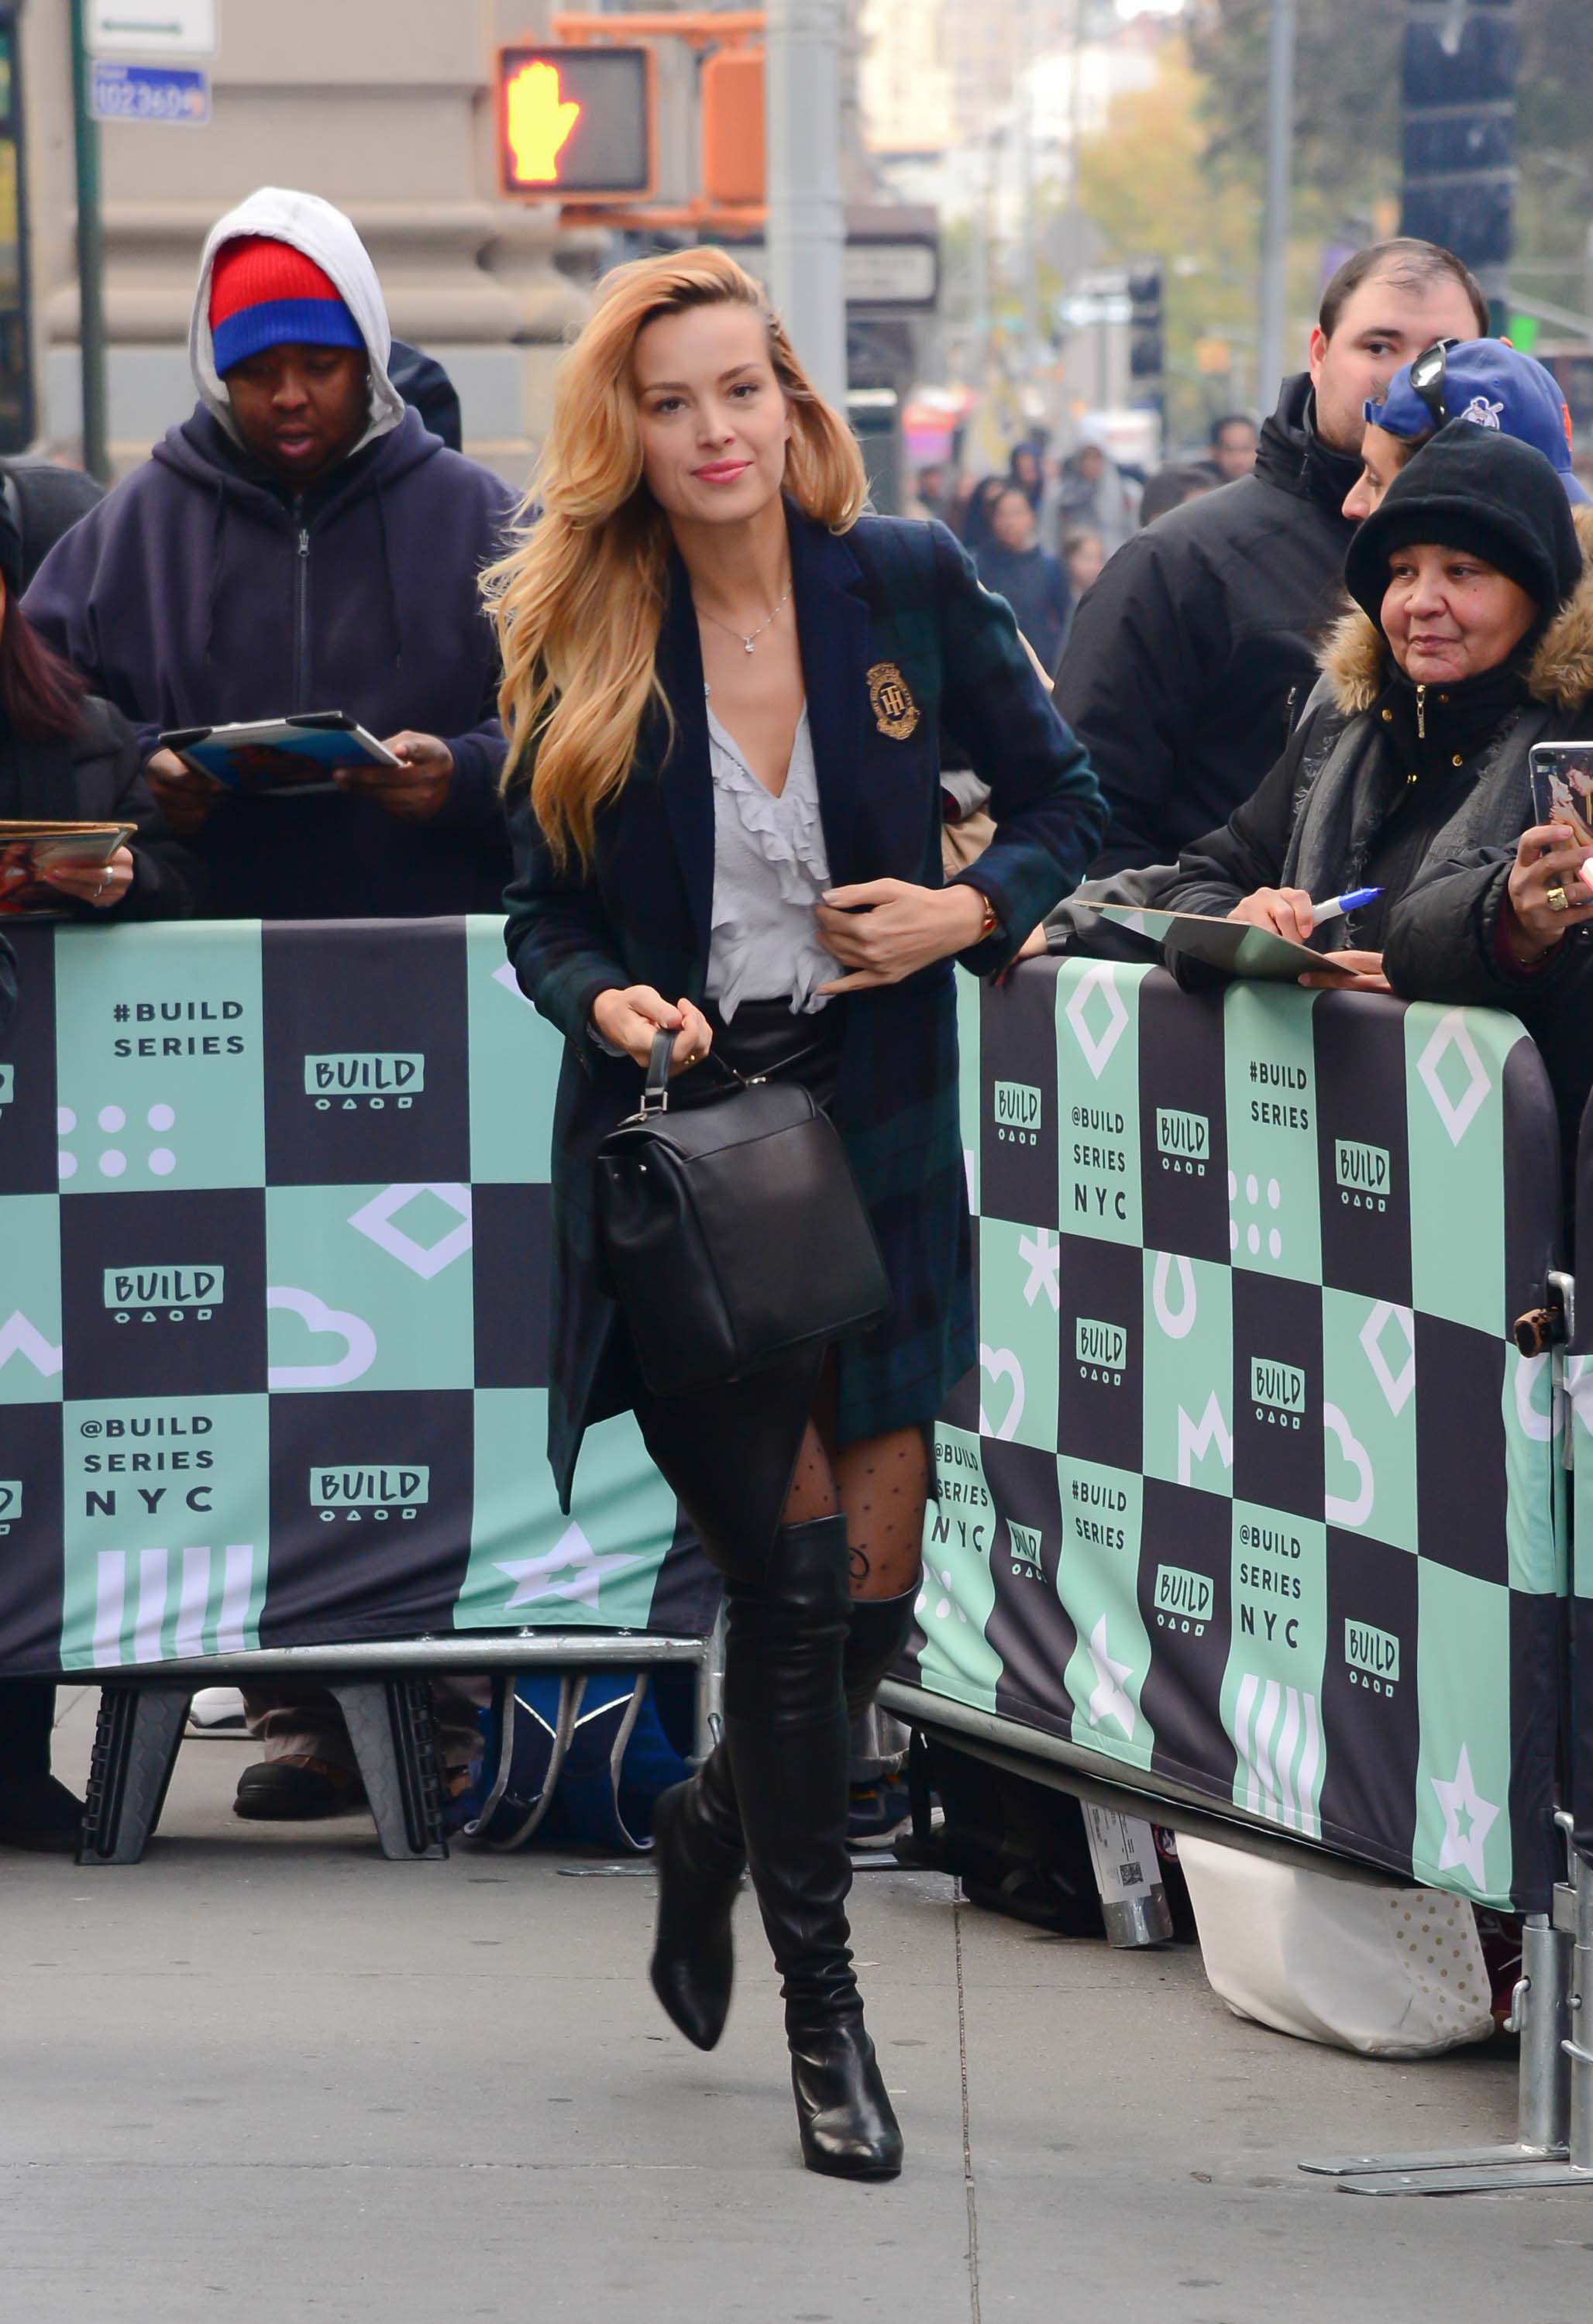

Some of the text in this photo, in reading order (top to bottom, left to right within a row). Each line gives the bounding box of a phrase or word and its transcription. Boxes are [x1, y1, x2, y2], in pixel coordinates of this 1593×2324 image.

[114, 1002, 243, 1022] #BUILD
[114, 1036, 244, 1057] SERIES
[316, 1058, 415, 1088] BUILD
[1251, 1061, 1306, 1090] #BUILD
[999, 1089, 1037, 1123] BUILD
[1072, 1107, 1123, 1133] @BUILD
[1251, 1101, 1308, 1129] SERIES
[1161, 1117, 1204, 1153] BUILD
[1074, 1144, 1125, 1172] SERIES
[1340, 1150, 1385, 1187] BUILD
[1075, 1184, 1126, 1219] NYC
[115, 1270, 215, 1301] BUILD
[1082, 1327, 1122, 1363] BUILD
[1257, 1367, 1300, 1404] BUILD
[81, 1417, 212, 1438] @BUILD
[84, 1450, 213, 1473] SERIES
[935, 1443, 978, 1470] @BUILD
[322, 1470, 420, 1501] BUILD
[938, 1479, 988, 1507] SERIES
[1072, 1480, 1126, 1511] #BUILD
[86, 1487, 212, 1516] NYC
[931, 1516, 985, 1552] NYC
[1075, 1518, 1123, 1549] SERIES
[1240, 1525, 1300, 1559] @BUILD
[1161, 1574, 1209, 1612] BUILD
[1240, 1563, 1300, 1599] SERIES
[1241, 1604, 1299, 1648] NYC
[1350, 1629, 1395, 1671] BUILD
